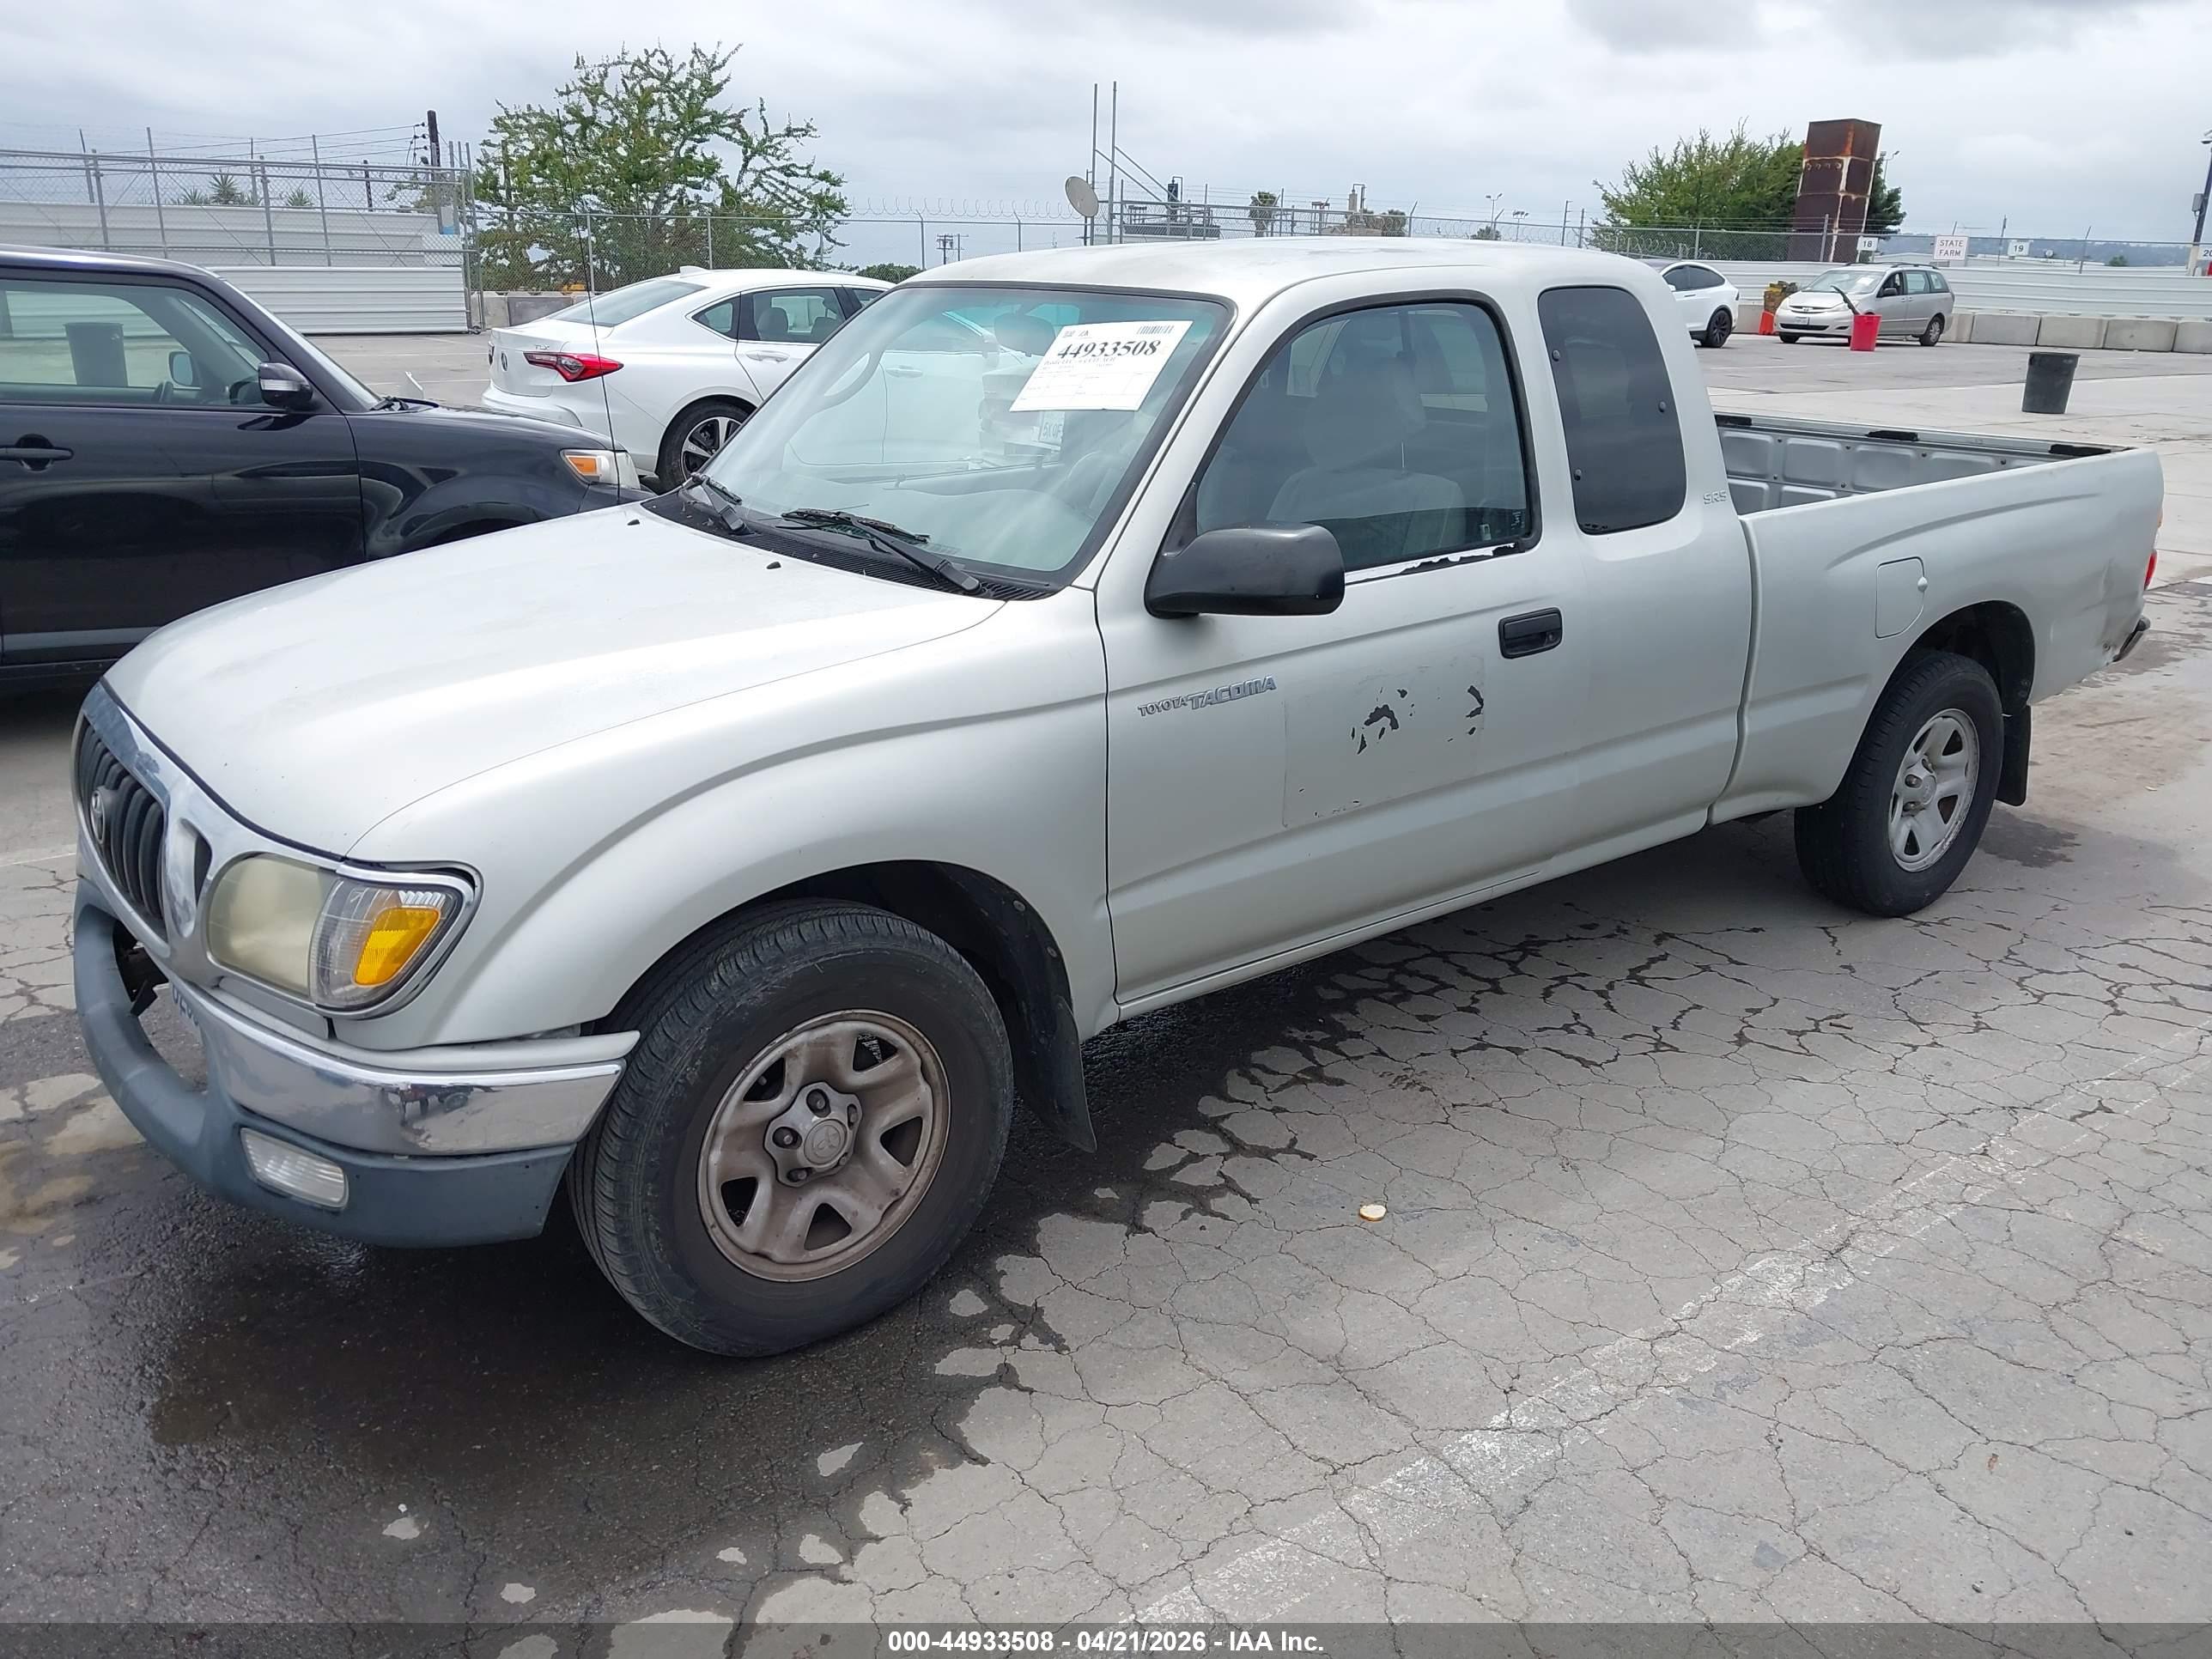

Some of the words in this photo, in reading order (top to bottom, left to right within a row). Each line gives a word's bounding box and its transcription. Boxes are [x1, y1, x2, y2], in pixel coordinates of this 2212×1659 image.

[1863, 240, 1873, 248] 18
[1057, 340, 1161, 358] 44933508
[1138, 696, 1187, 717] TOYOTA
[1188, 675, 1277, 710] TACOMA
